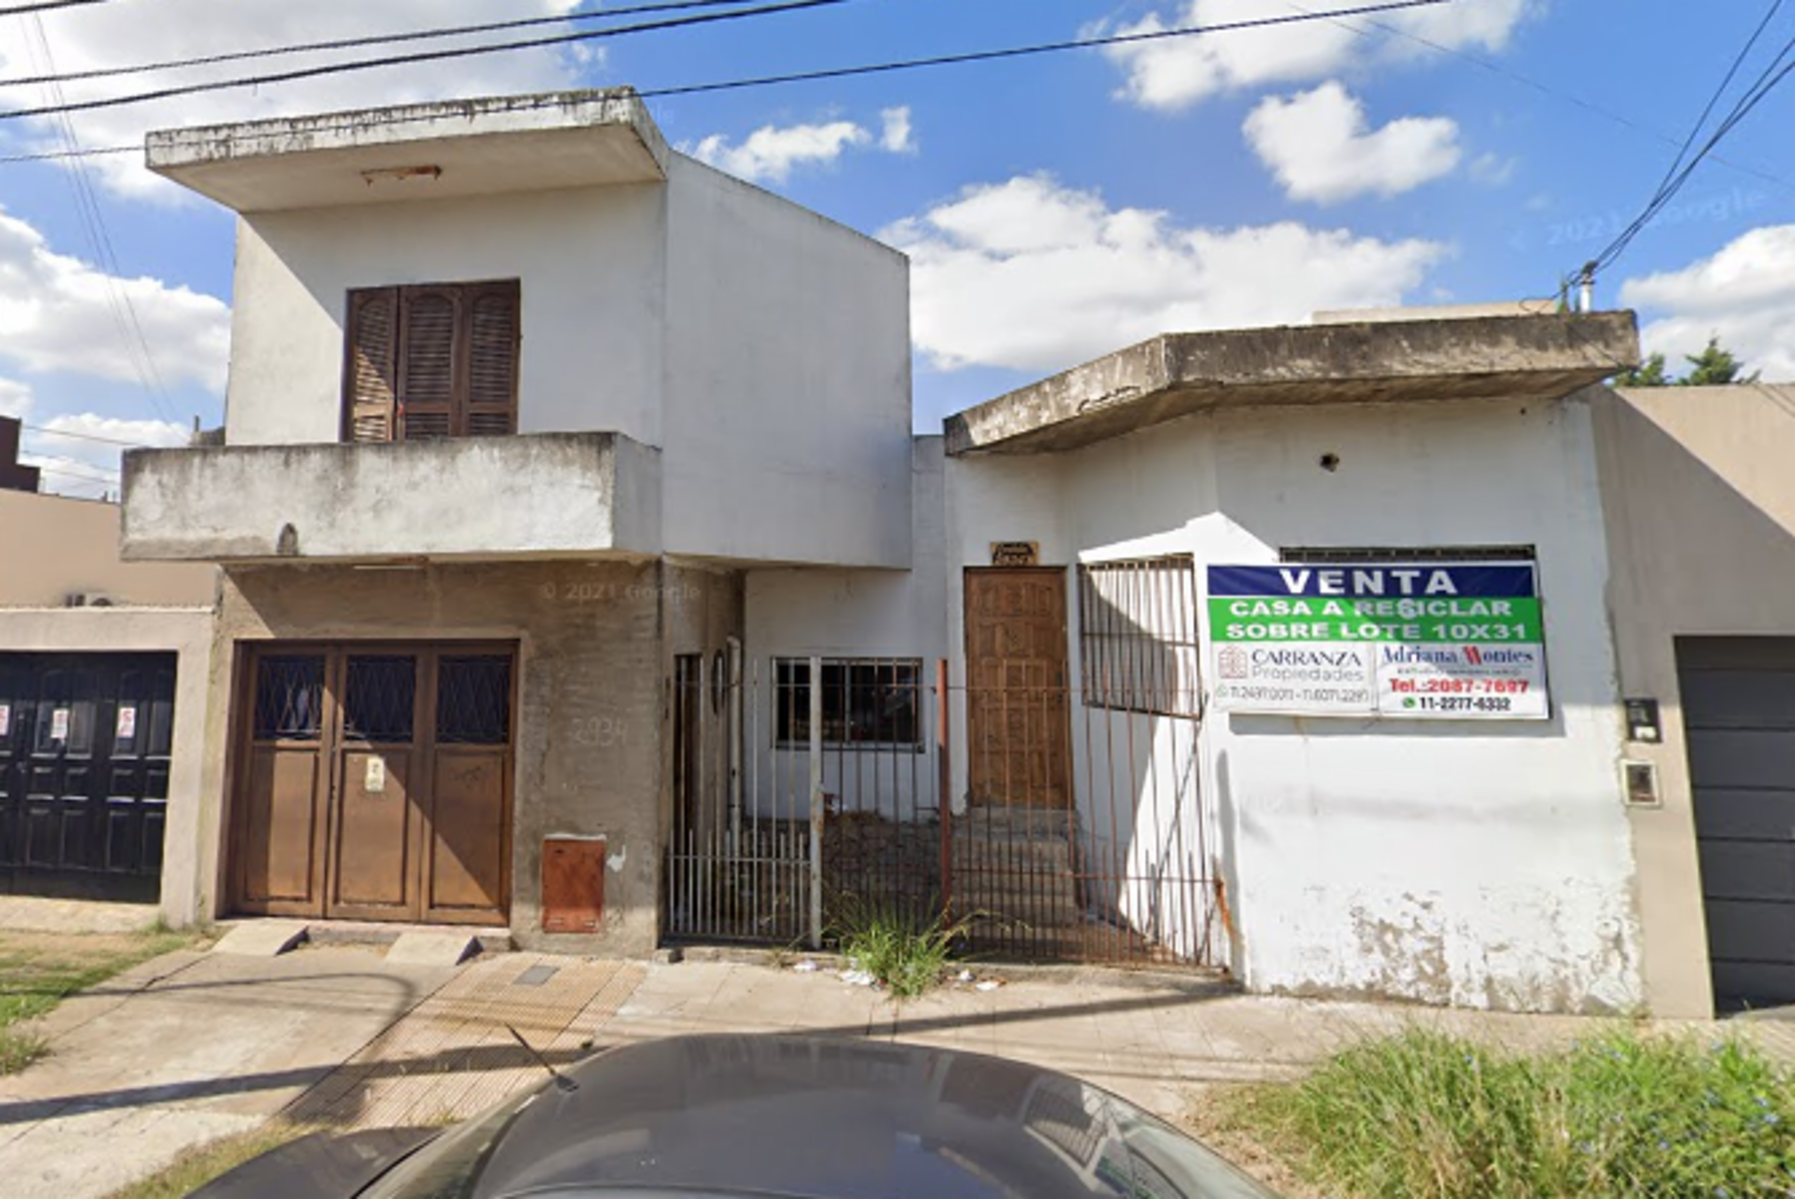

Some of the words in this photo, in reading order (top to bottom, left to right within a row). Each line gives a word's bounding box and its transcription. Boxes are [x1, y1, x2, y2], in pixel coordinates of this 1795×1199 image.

[1279, 568, 1458, 595] VENTA
[1229, 600, 1313, 618] CASA
[1322, 600, 1344, 616] A
[1226, 622, 1330, 640] SOBRE
[1340, 622, 1421, 640] LOTE
[1432, 623, 1526, 640] 10X31
[1252, 648, 1362, 667] CARRANZA
[1384, 645, 1458, 664] Adriana
[1252, 665, 1364, 682] Propiedades
